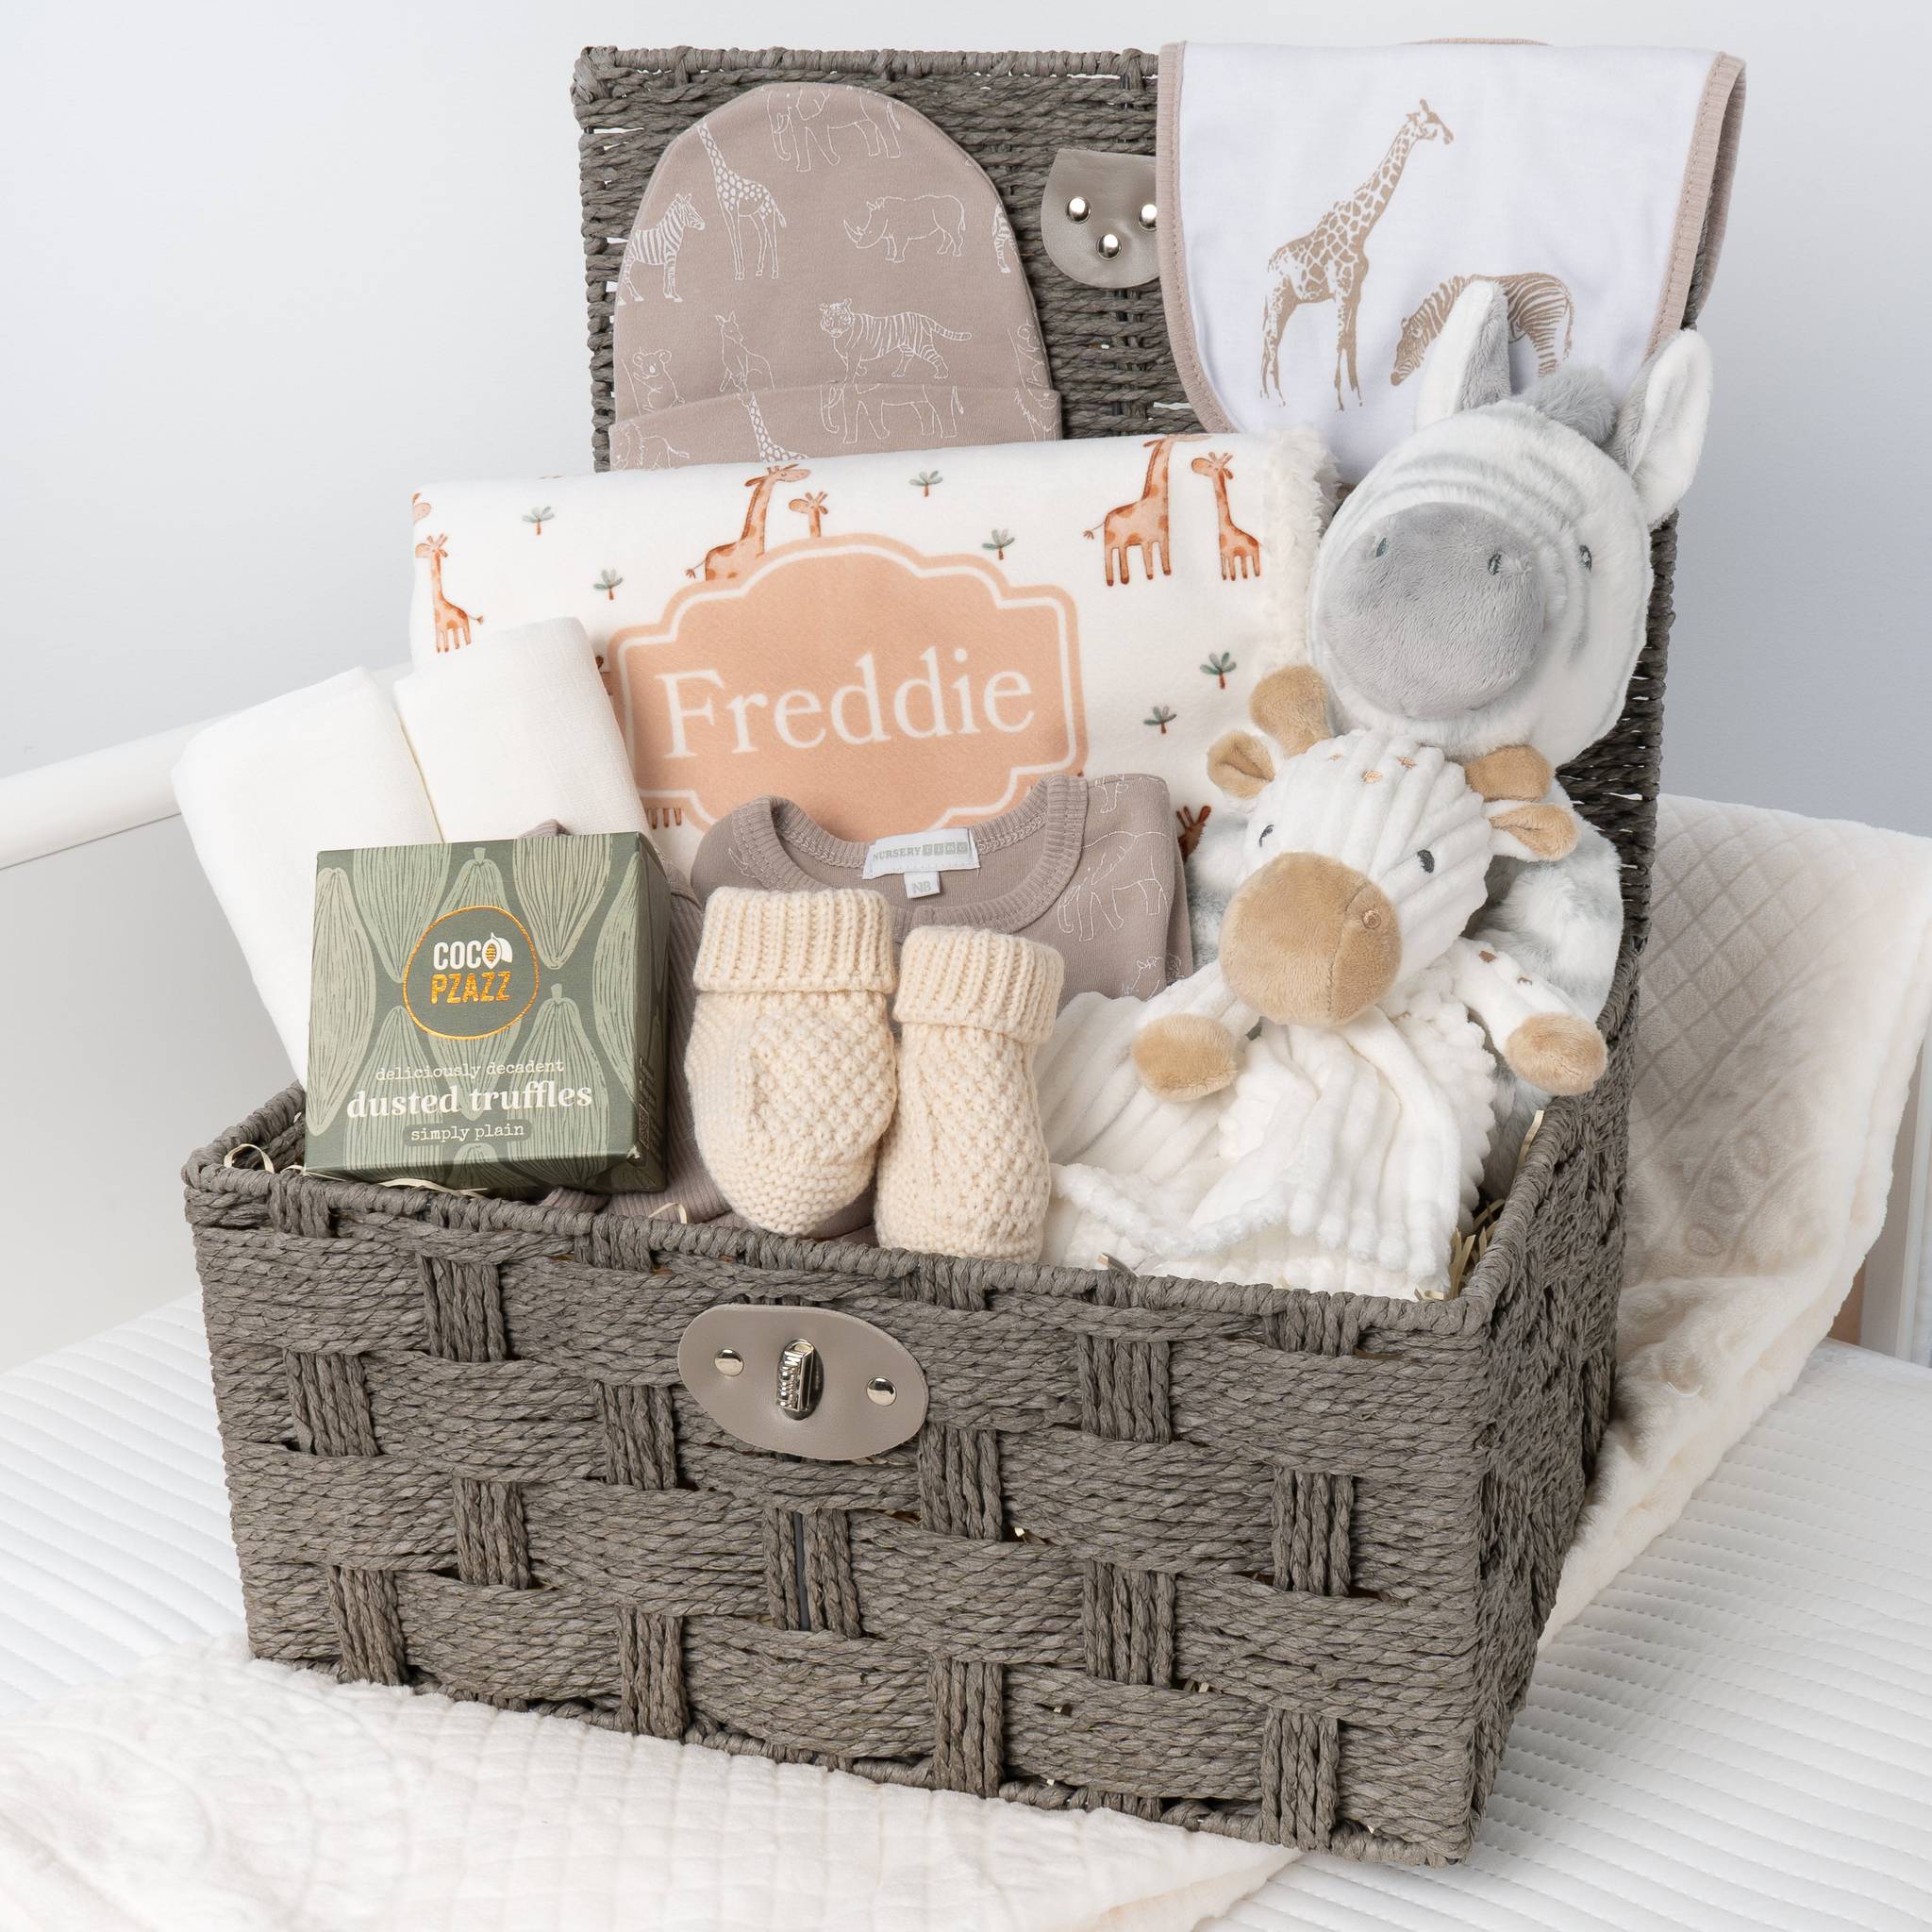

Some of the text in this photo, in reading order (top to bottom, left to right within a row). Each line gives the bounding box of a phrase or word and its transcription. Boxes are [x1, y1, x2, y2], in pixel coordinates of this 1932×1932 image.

[655, 645, 1035, 758] Freddie
[873, 847, 921, 861] NURSERY
[911, 881, 932, 893] NB
[433, 932, 509, 971] COCO
[431, 972, 511, 1004] PZAZZ
[376, 1059, 565, 1081] deliciously decadent
[346, 1080, 592, 1118] dusted truffles
[410, 1124, 525, 1141] simply plain
